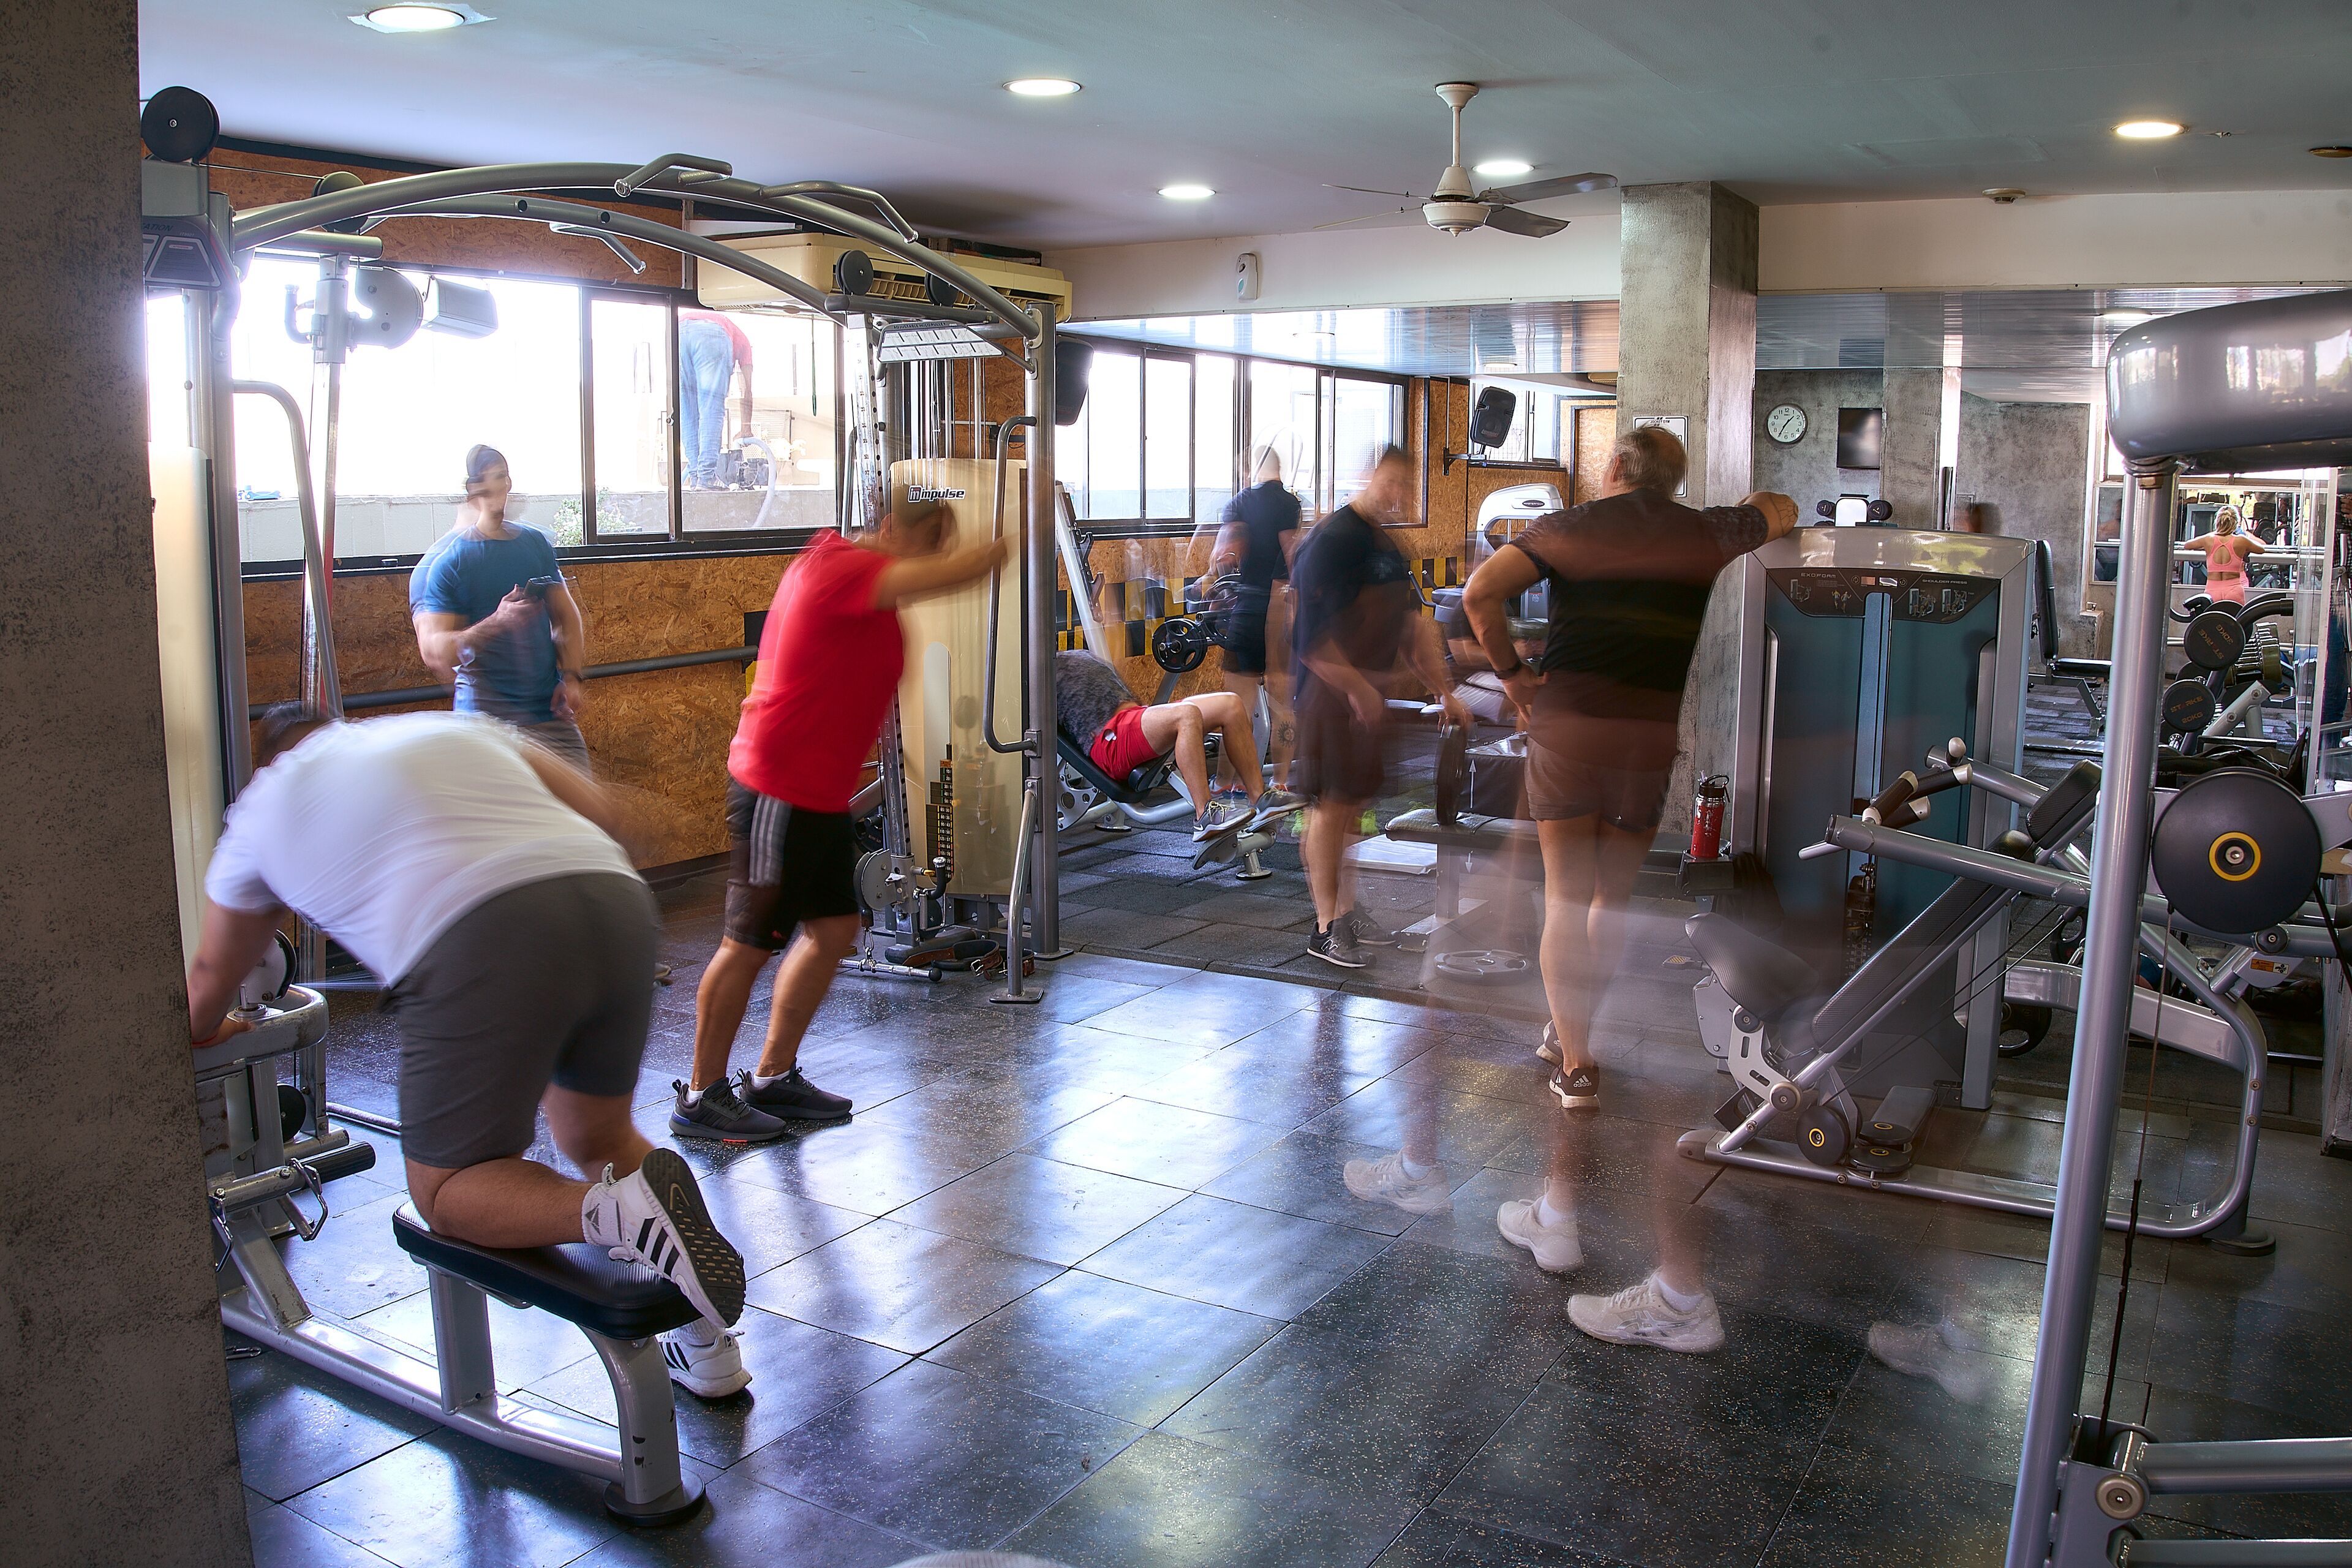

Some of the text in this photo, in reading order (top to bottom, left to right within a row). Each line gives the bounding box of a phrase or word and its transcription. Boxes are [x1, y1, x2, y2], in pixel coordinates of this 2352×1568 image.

[921, 489, 965, 500] impulse
[2216, 625, 2233, 644] 30KG
[2199, 629, 2224, 659] STARKE
[2171, 696, 2203, 712] STARKE
[2181, 712, 2203, 723] 20KG
[1321, 938, 1338, 956] N
